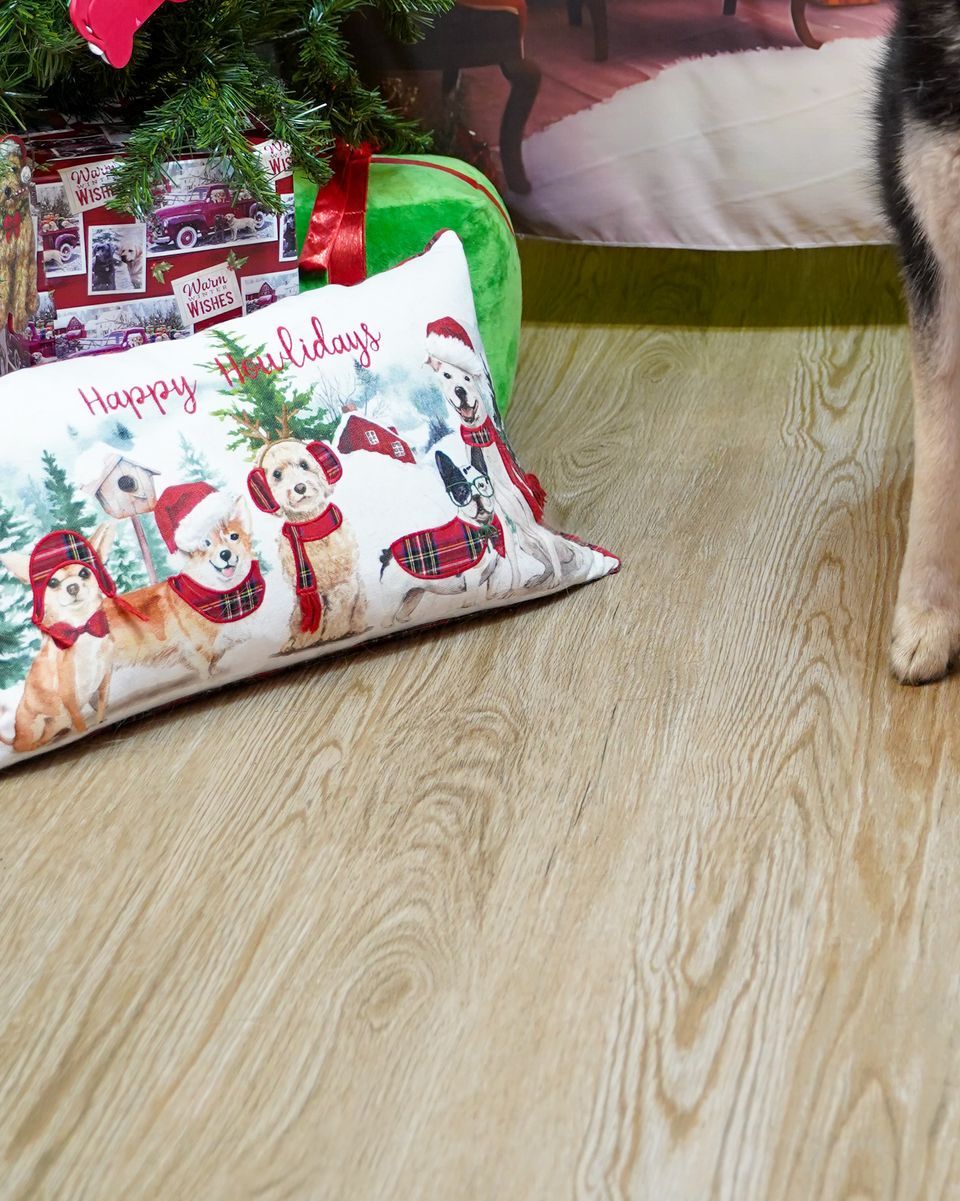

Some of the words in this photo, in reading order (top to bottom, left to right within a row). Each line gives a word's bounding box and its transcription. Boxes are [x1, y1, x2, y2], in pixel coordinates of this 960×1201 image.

[183, 275, 228, 297] Warm
[186, 291, 234, 318] WISHES
[78, 375, 197, 419] Happy
[213, 315, 382, 388] Howlidays
